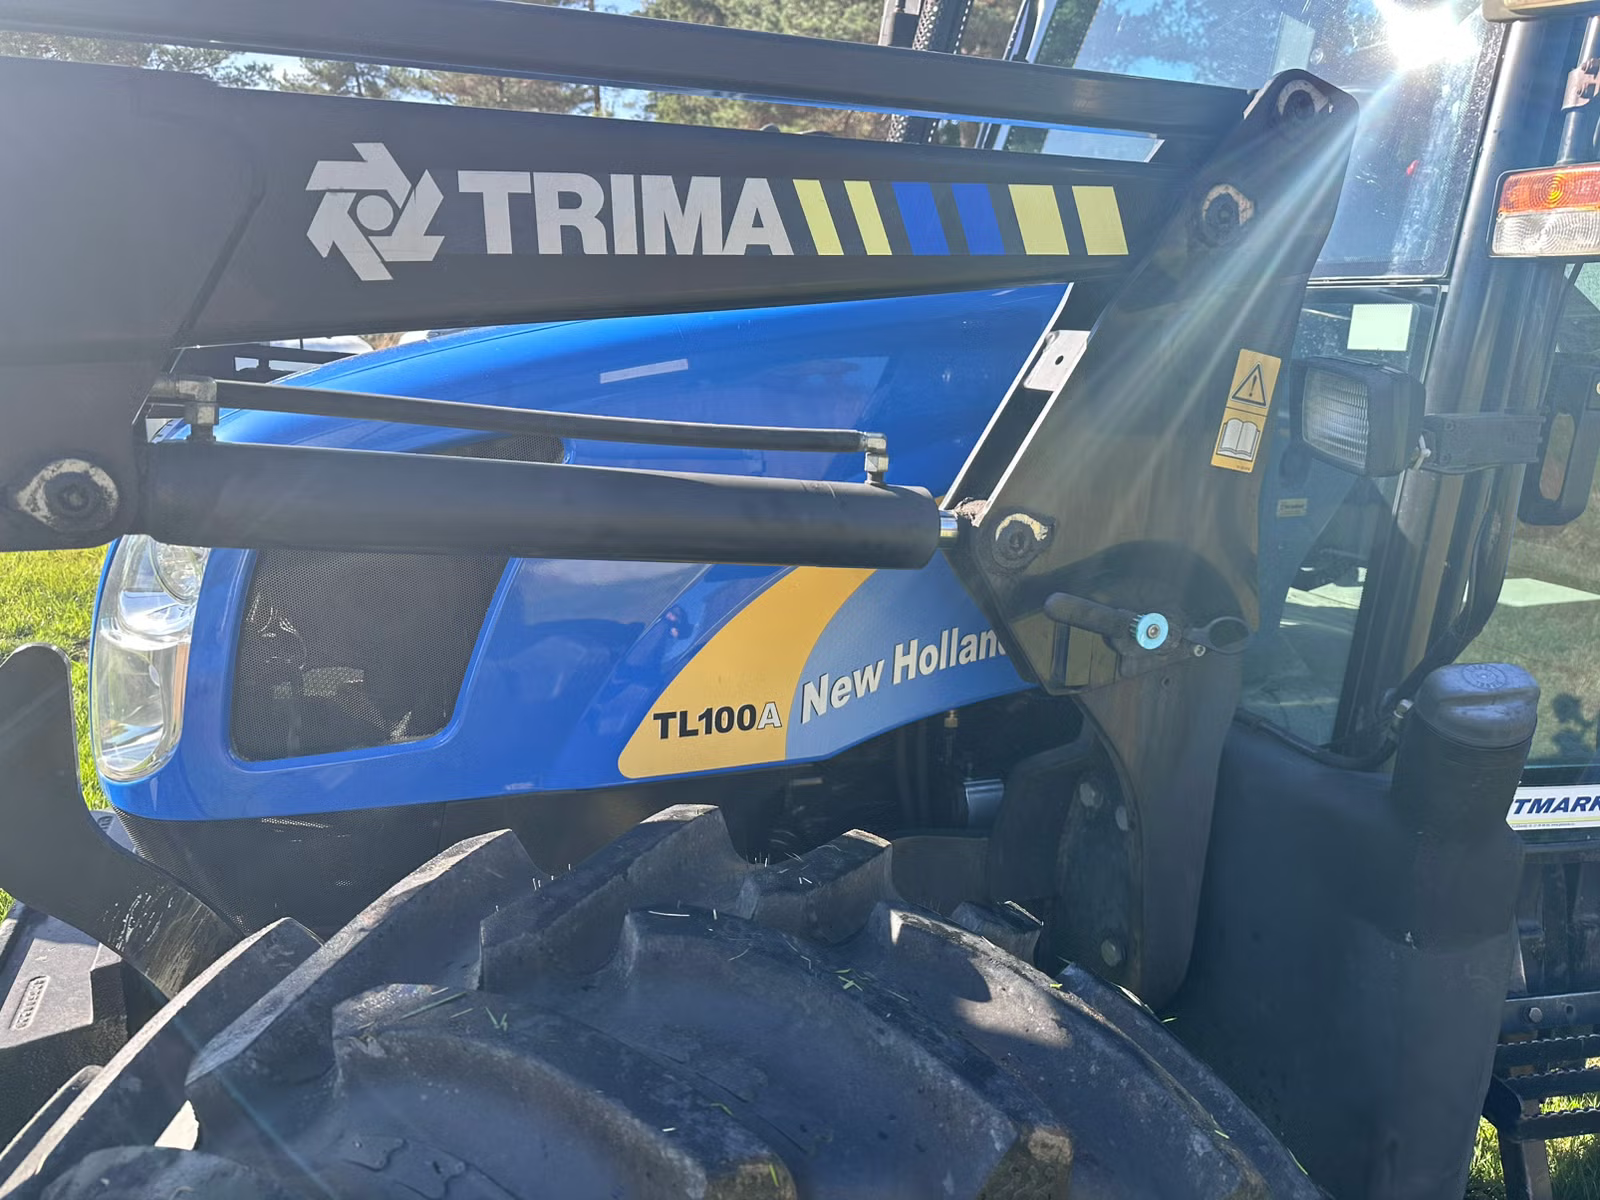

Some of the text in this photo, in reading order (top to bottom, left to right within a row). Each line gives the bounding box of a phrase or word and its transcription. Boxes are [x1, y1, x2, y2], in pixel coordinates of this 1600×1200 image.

[458, 170, 795, 256] TRIMA
[801, 627, 1006, 724] New Hollan
[653, 701, 782, 740] TL100A
